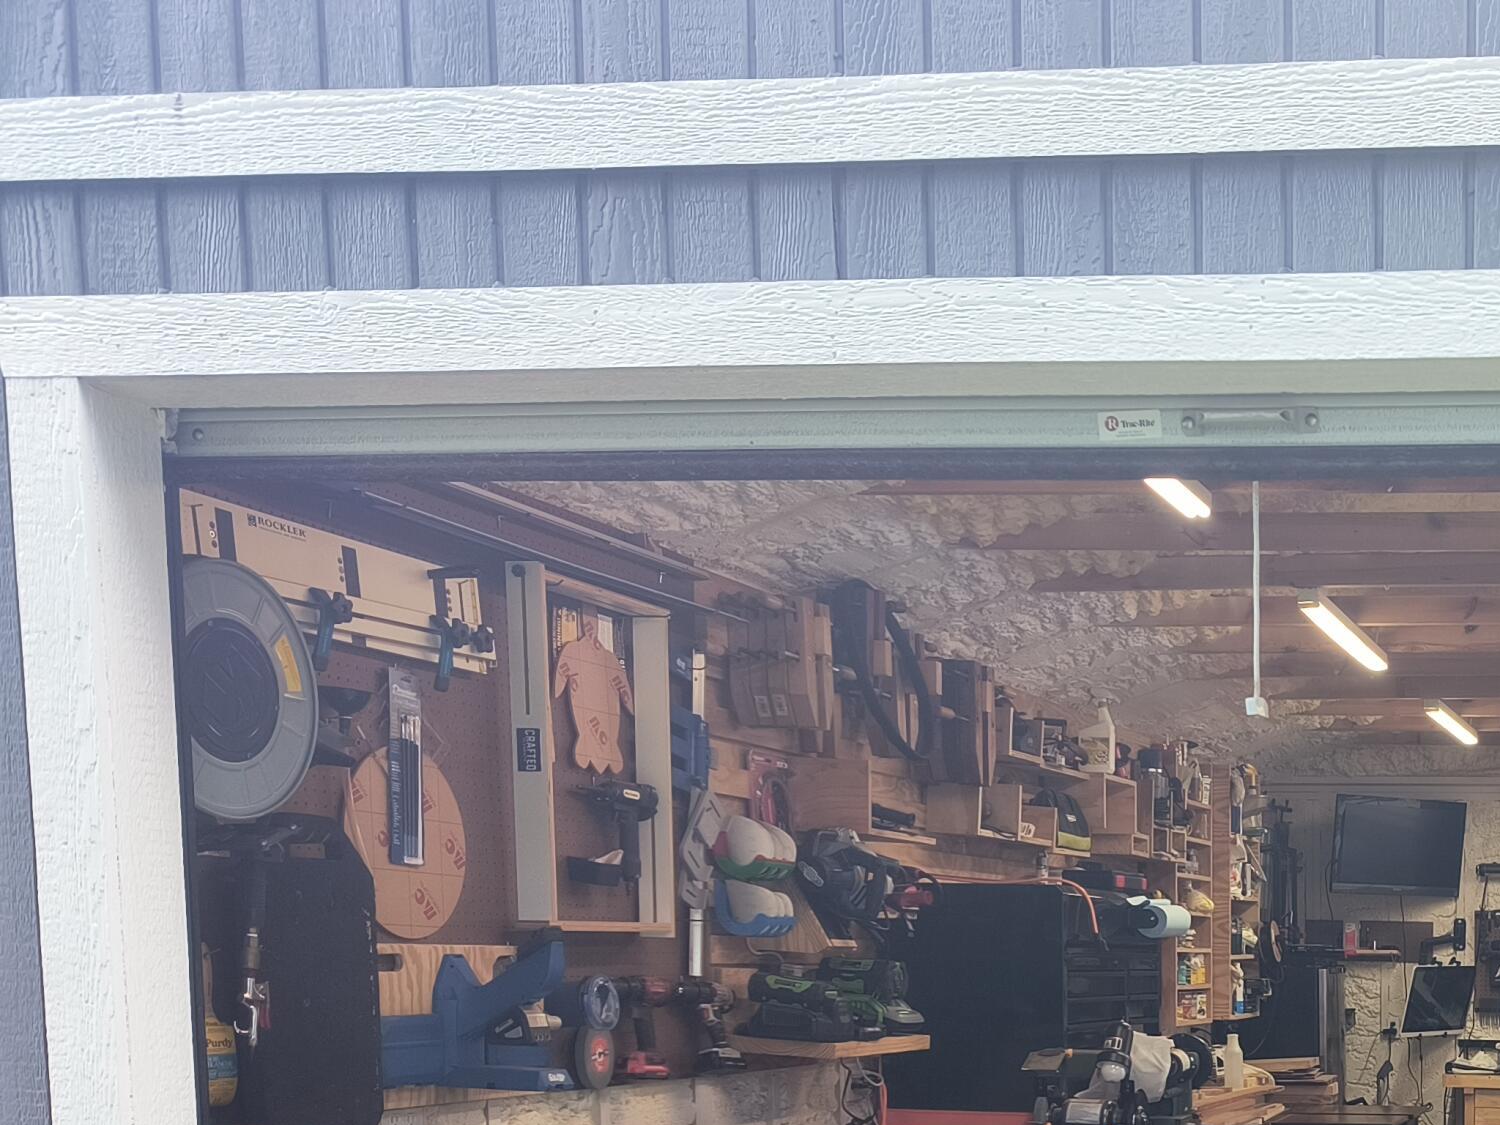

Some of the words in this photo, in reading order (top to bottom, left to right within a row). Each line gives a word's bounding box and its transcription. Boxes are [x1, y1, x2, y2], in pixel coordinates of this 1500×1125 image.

[258, 516, 307, 537] ROCKLER
[524, 729, 537, 770] CRAFTED
[206, 1038, 233, 1049] Purdy
